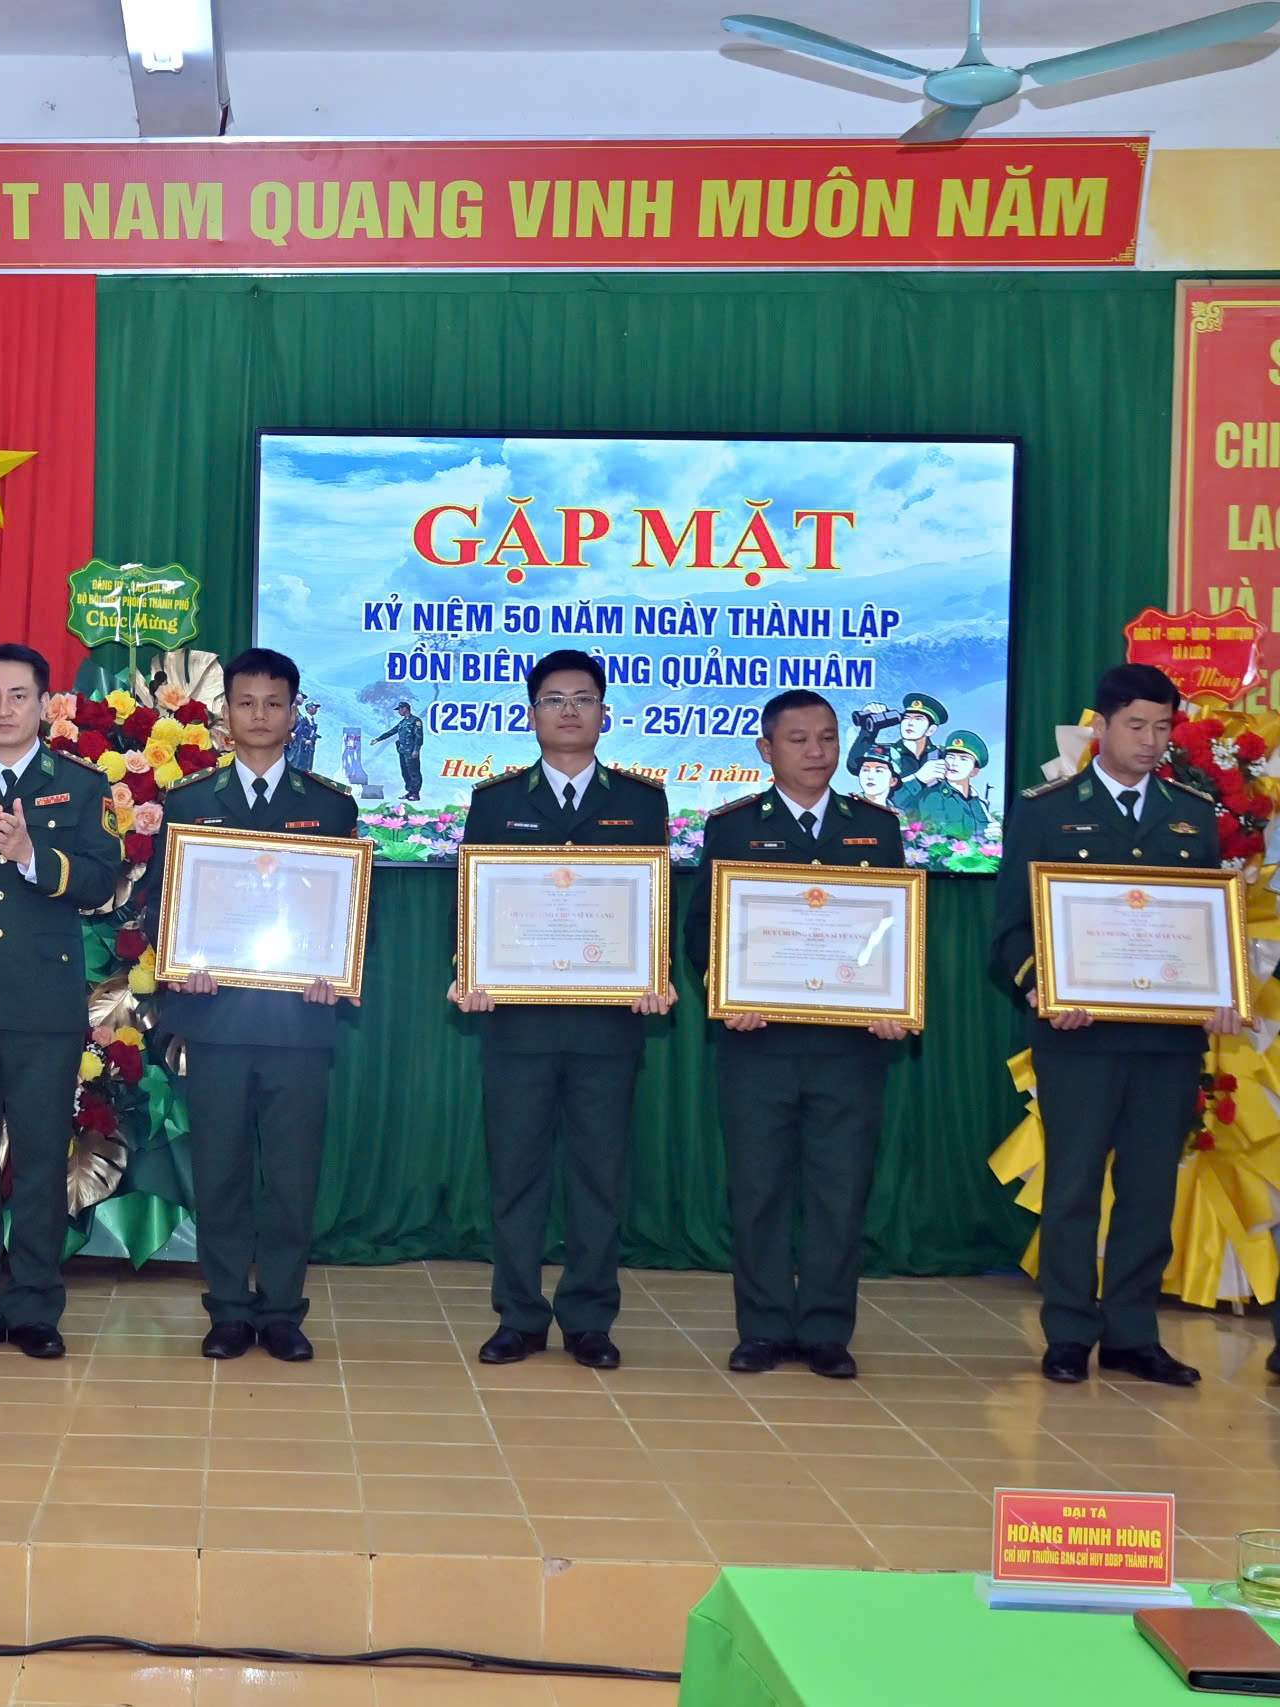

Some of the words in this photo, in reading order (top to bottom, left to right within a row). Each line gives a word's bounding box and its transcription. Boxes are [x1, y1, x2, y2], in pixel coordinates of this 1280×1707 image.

[64, 182, 224, 239] NAM
[250, 180, 482, 247] QUANG
[509, 180, 671, 238] VINH
[698, 166, 916, 238] MUÔN
[936, 164, 1109, 237] NĂM
[412, 496, 610, 585] GẶP
[631, 498, 855, 588] MẶT
[86, 610, 127, 628] Chúc
[133, 613, 178, 634] Mừng
[364, 593, 403, 631] KỶ
[413, 598, 492, 638] NIỆM
[504, 605, 540, 633] 50
[551, 599, 622, 634] NĂM
[635, 600, 718, 636] NGÀY
[727, 603, 830, 637] THÀNH
[842, 604, 899, 644] LẬP
[387, 643, 450, 681] ĐỒN
[463, 649, 534, 682] BIÊN
[663, 648, 767, 688] QUẢNG
[780, 655, 873, 687] NHÂM
[440, 755, 494, 778] Huế,
[675, 764, 702, 781] 12
[709, 765, 760, 782] năm
[1063, 1506, 1086, 1519] ĐẠI
[1090, 1505, 1107, 1519] TÁ
[1007, 1521, 1063, 1544] HOÀNG
[1068, 1526, 1111, 1546] MINH
[1116, 1525, 1161, 1548] HÙNG
[1017, 1549, 1031, 1563] HUY
[1061, 1551, 1075, 1565] BAN
[1090, 1552, 1103, 1566] HUY
